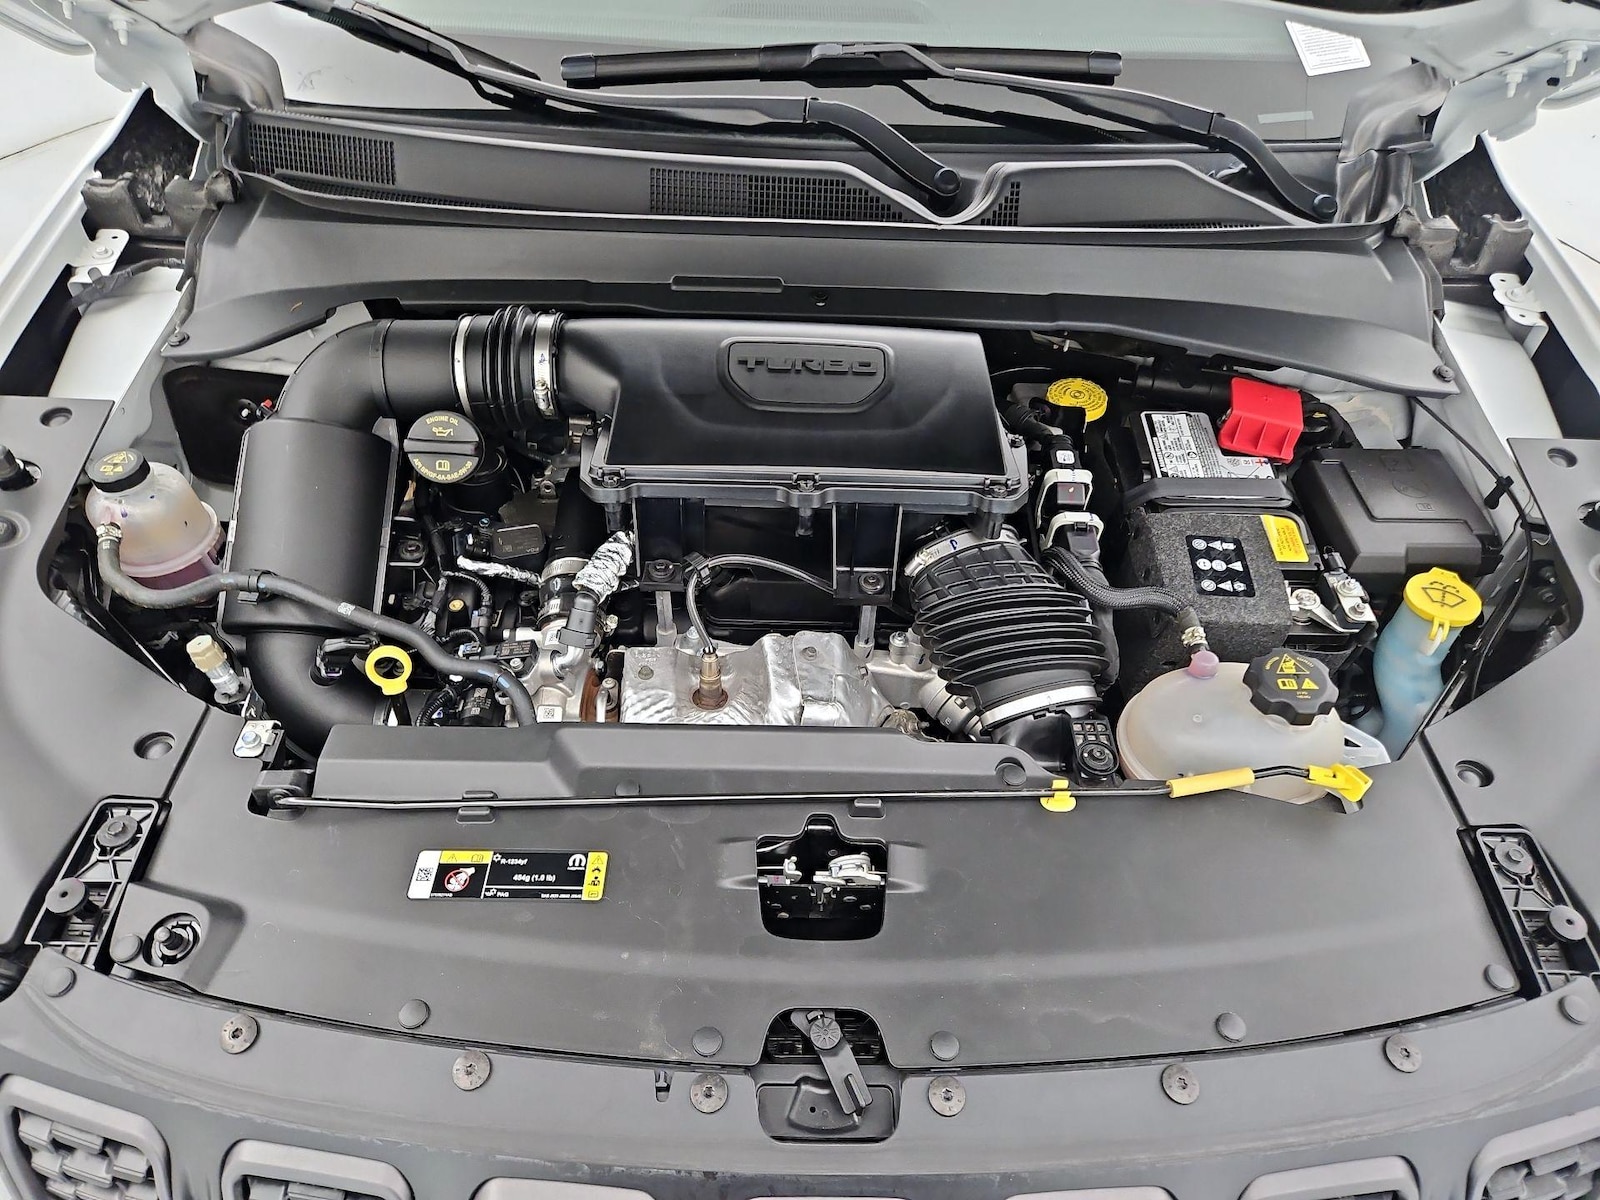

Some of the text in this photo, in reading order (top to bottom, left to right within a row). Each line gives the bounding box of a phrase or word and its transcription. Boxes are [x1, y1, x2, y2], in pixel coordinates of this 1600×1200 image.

[737, 355, 877, 375] TURBO
[426, 415, 459, 426] ENGINE OIL
[500, 858, 528, 866] R-1234yf
[513, 873, 556, 883] 454g (1.0 lb)
